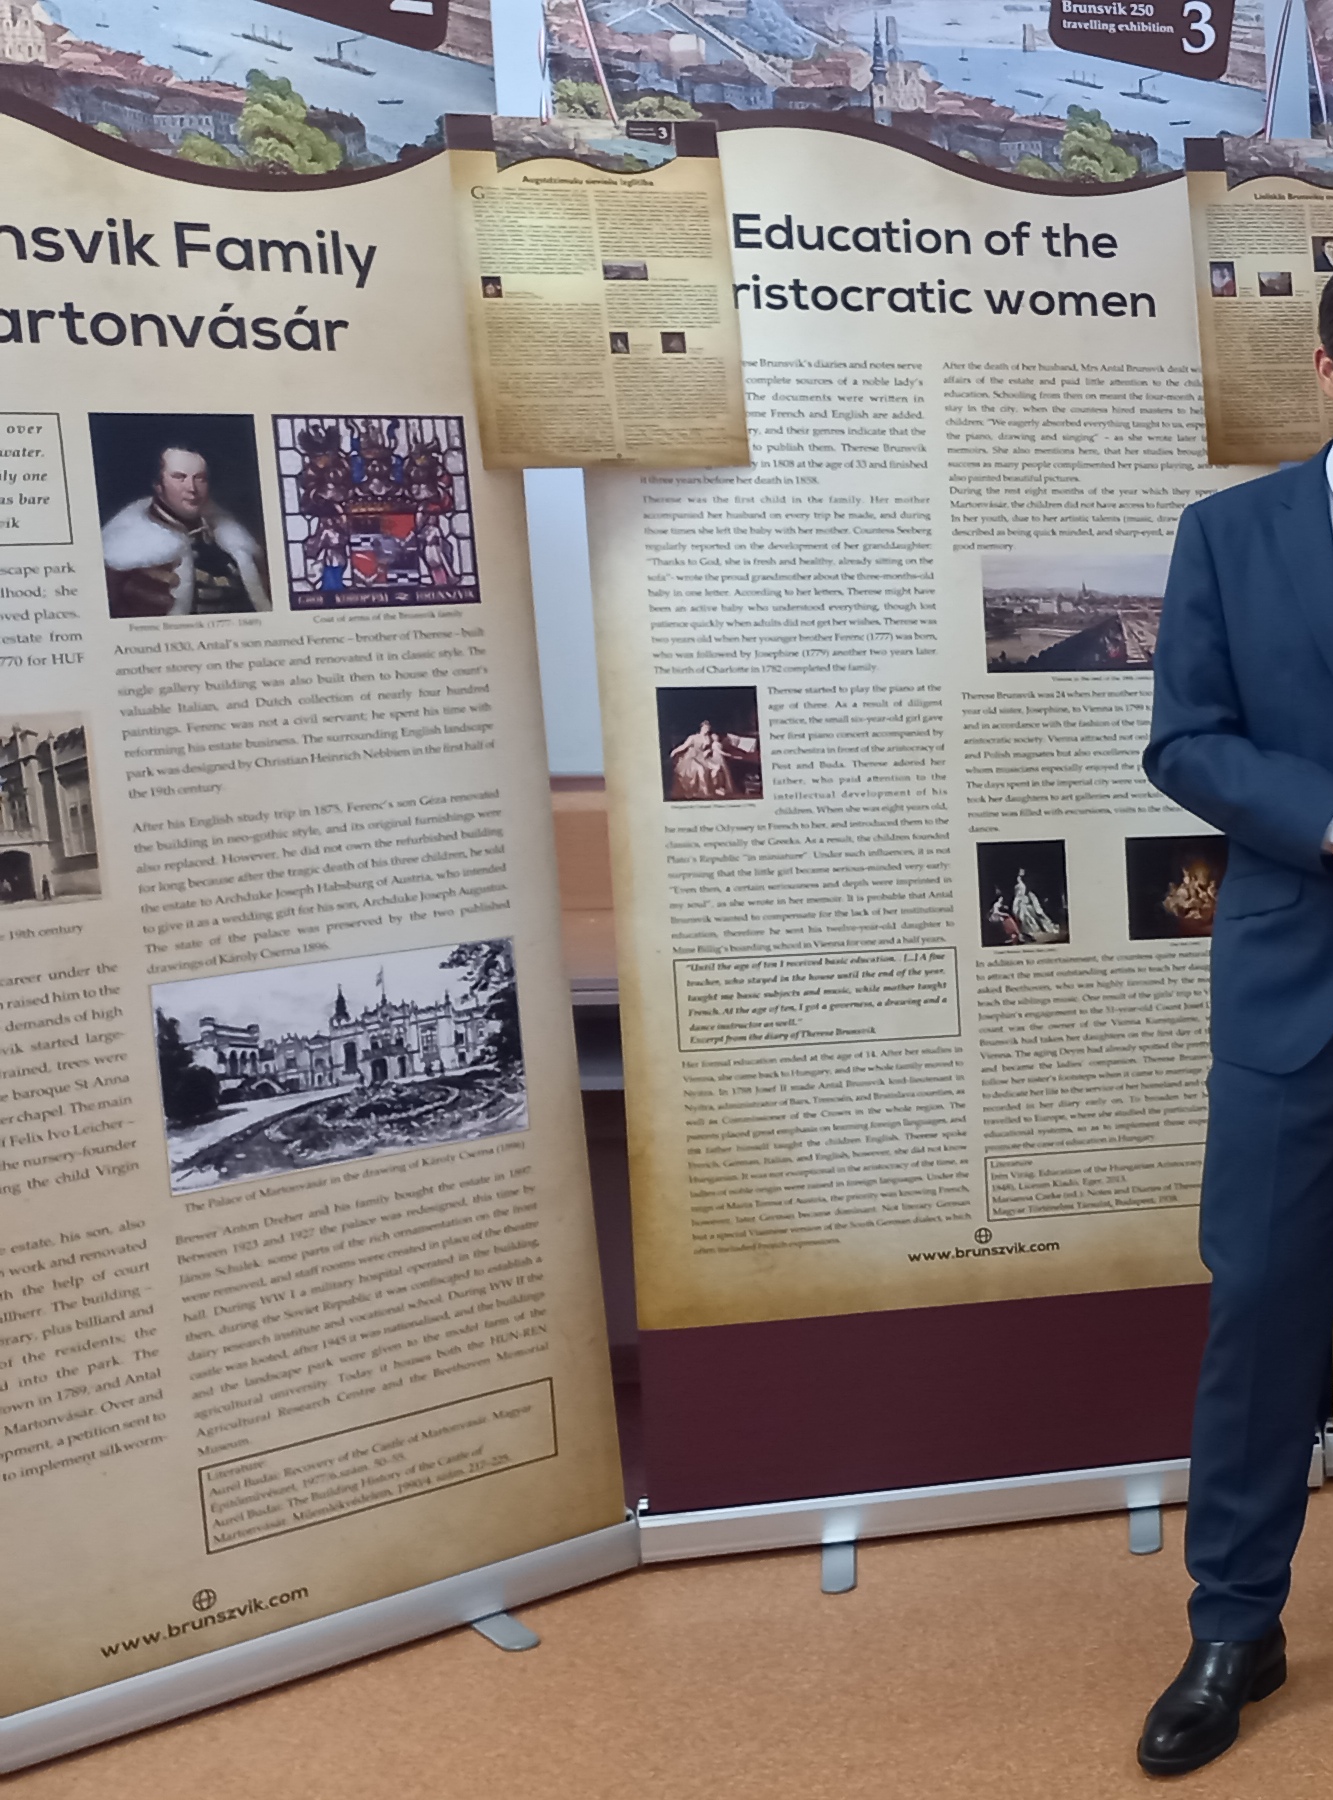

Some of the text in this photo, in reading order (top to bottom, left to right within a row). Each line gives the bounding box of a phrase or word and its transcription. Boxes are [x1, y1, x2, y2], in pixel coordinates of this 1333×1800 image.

[1061, 0, 1154, 17] Brunsvik 250
[1062, 19, 1175, 34] travelling exhibition
[1181, 0, 1216, 54] 3
[658, 126, 668, 140] 3
[732, 213, 1119, 259] Education of the
[173, 221, 378, 289] Family
[731, 273, 1157, 318] ristocratic women
[746, 391, 766, 401] The
[913, 393, 925, 403] in
[22, 473, 47, 481] one
[0, 651, 84, 667] 770 for HUF
[907, 1239, 1061, 1263] www.brunszvik.com
[100, 1584, 309, 1660] www.brunszvik.com
